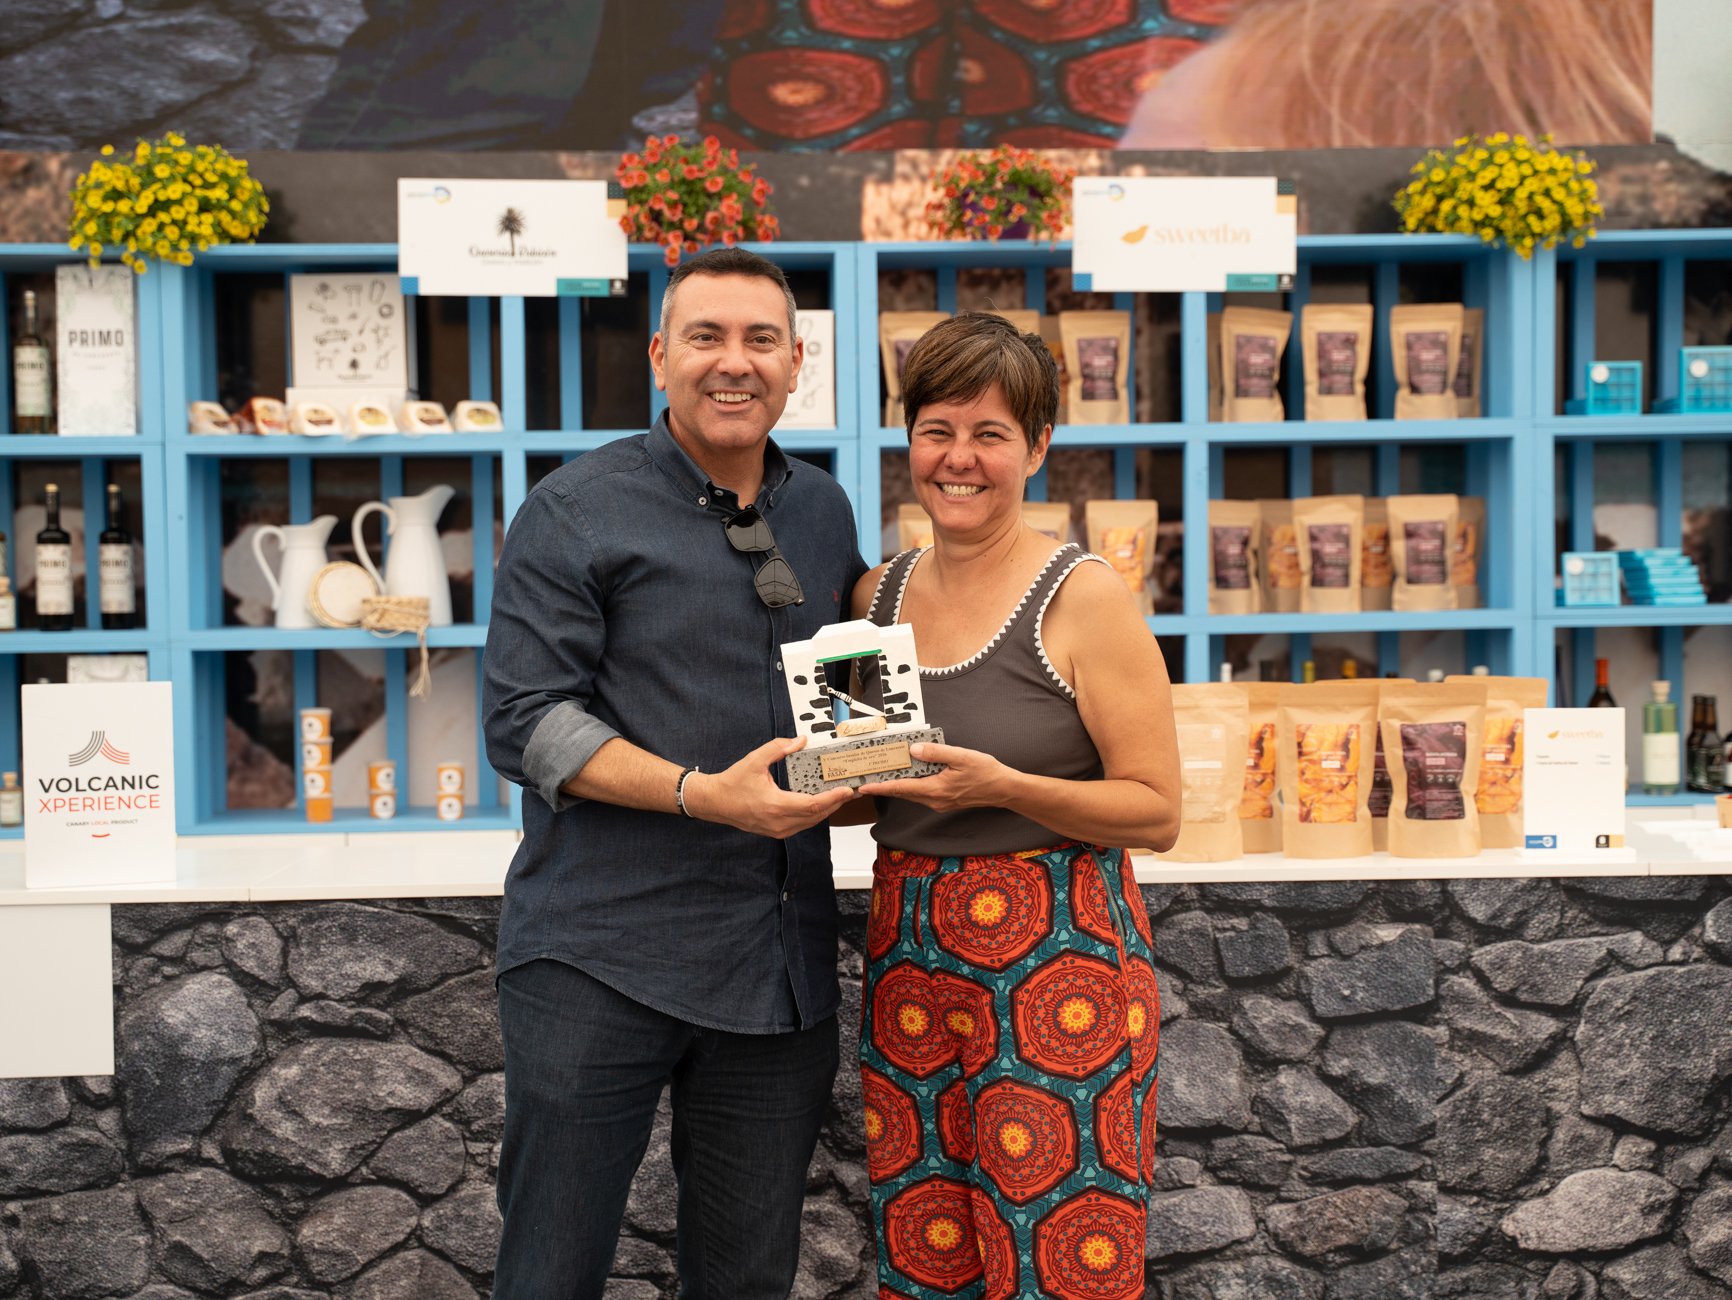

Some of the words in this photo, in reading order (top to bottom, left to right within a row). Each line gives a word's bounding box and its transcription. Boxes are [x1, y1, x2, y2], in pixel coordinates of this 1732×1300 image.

[68, 329, 124, 348] PRIMO
[38, 774, 160, 793] VOLCANIC
[38, 794, 161, 813] XPERIENCE
